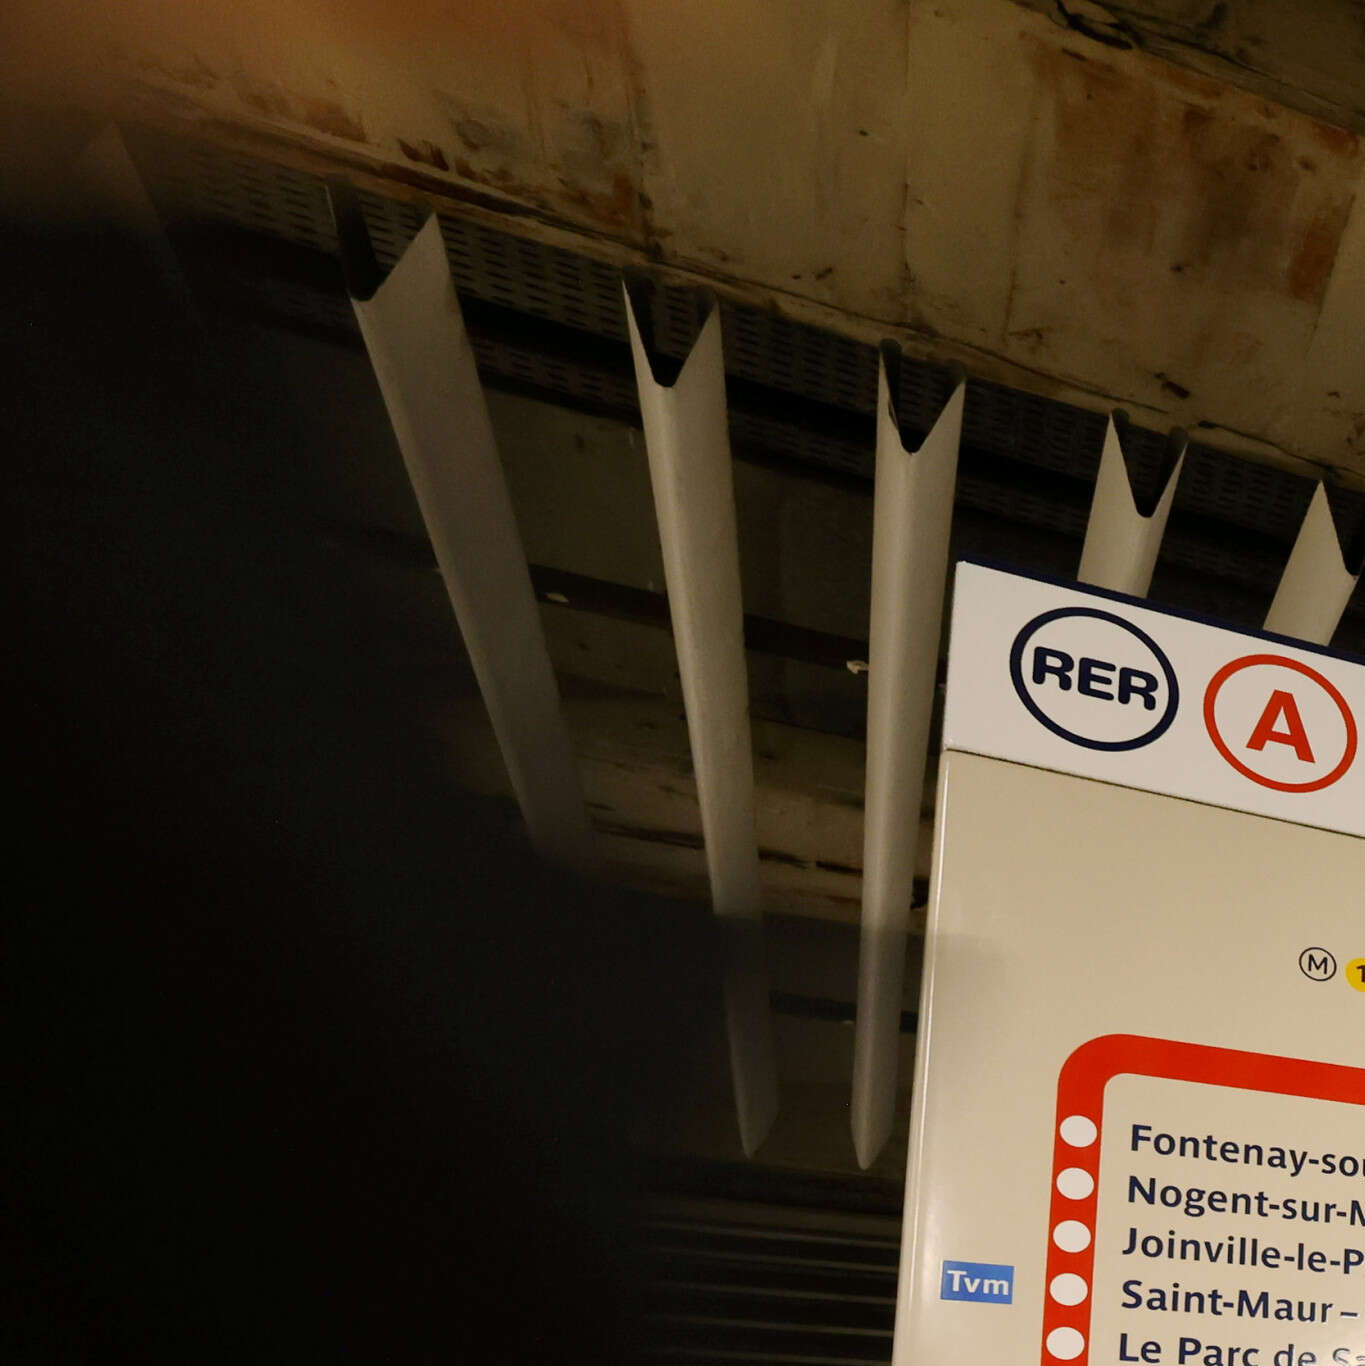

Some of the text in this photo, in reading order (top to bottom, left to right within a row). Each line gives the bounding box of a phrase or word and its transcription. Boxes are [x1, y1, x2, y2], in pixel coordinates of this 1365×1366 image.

[1032, 646, 1315, 764] RER A
[1308, 954, 1328, 974] M
[1356, 965, 1365, 982] 1
[947, 1270, 1009, 1295] Tvm
[1122, 1280, 1333, 1323] Saint-Maur
[1119, 1333, 1161, 1364] Le
